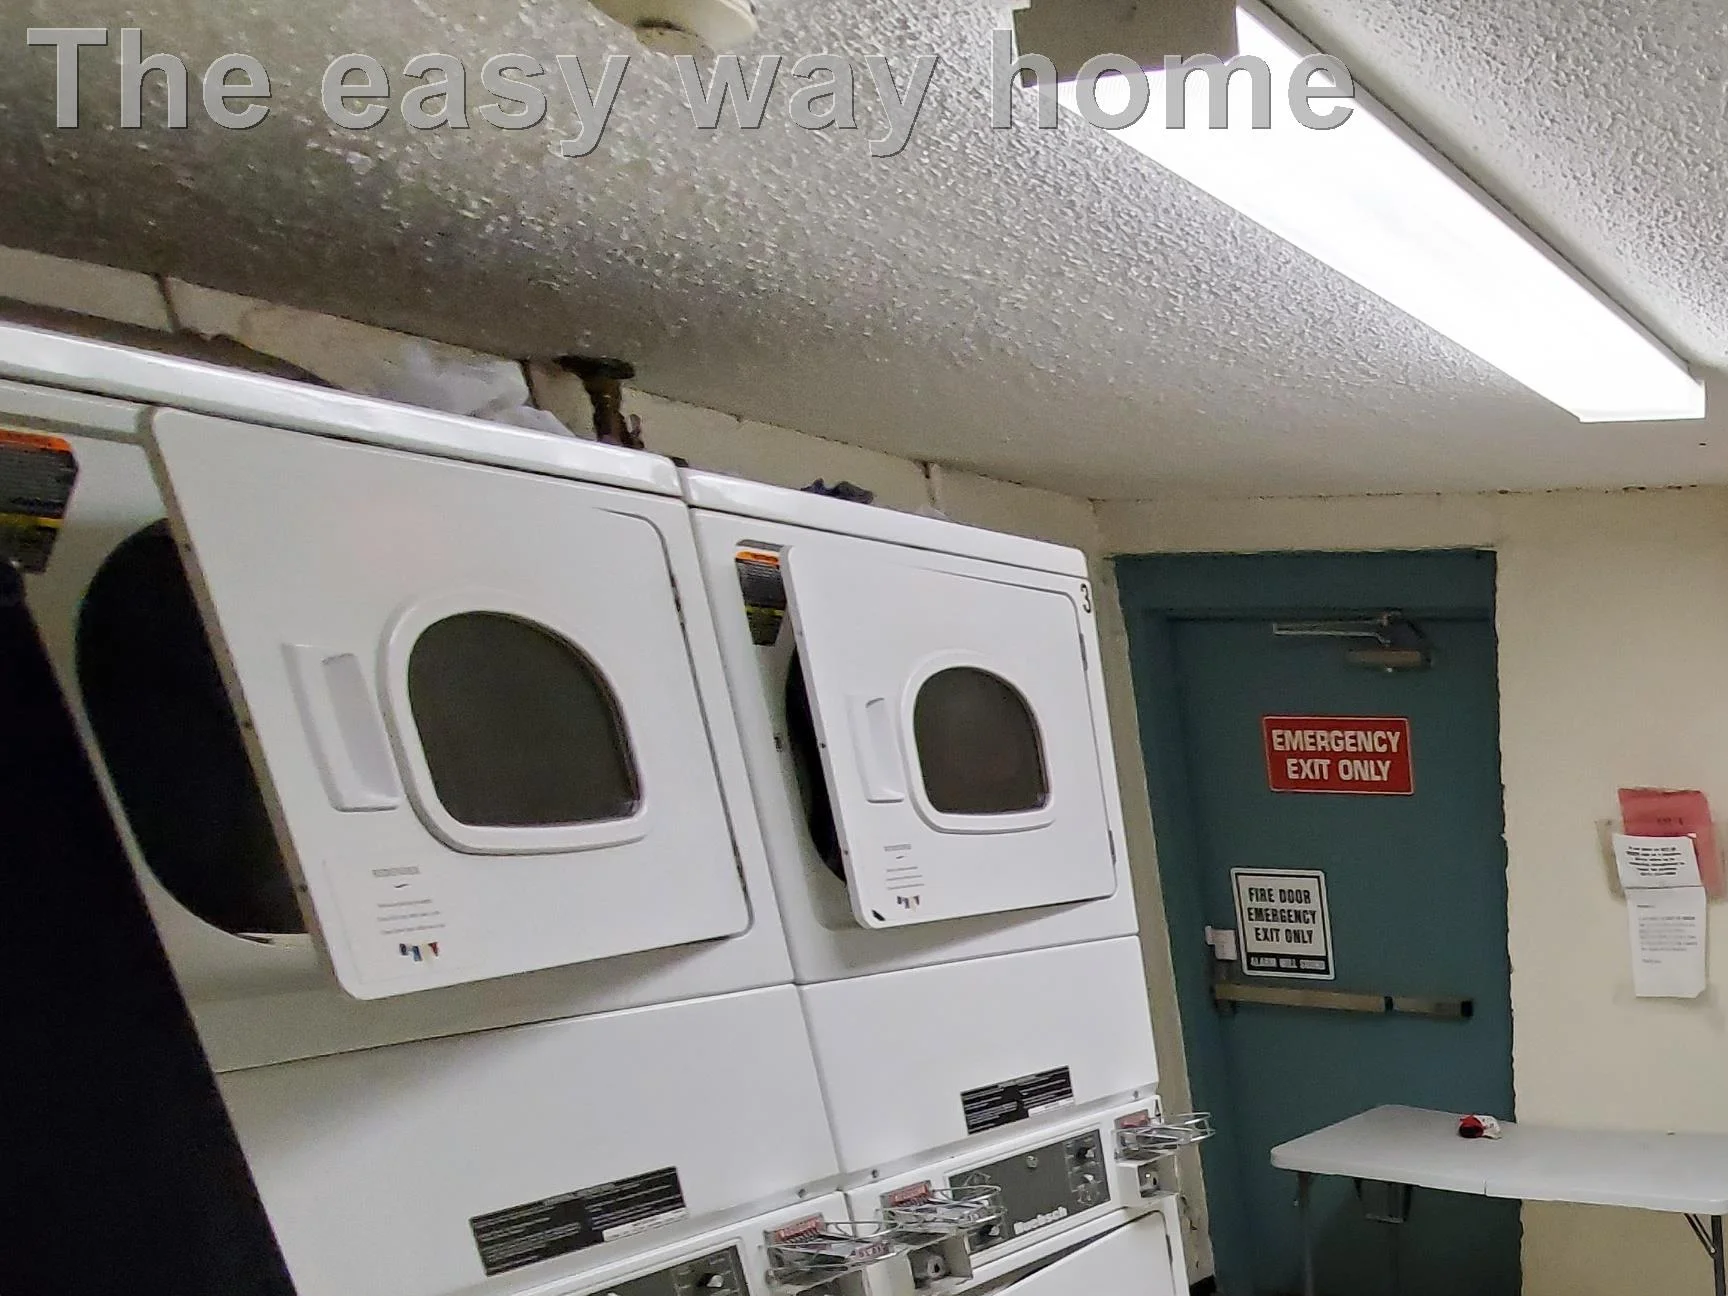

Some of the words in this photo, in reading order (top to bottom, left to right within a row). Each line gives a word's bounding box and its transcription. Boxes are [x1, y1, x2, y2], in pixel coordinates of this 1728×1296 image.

[1080, 583, 1091, 613] 3
[1272, 729, 1400, 753] EMERGENCY
[1287, 758, 1331, 780] EXIT
[1338, 759, 1391, 781] ONLY
[1248, 887, 1274, 903] FIRE
[1279, 889, 1310, 904] DOOR
[1248, 907, 1317, 925] EMERGENCY
[1254, 927, 1280, 943] EXIT
[1285, 929, 1313, 944] ONLY
